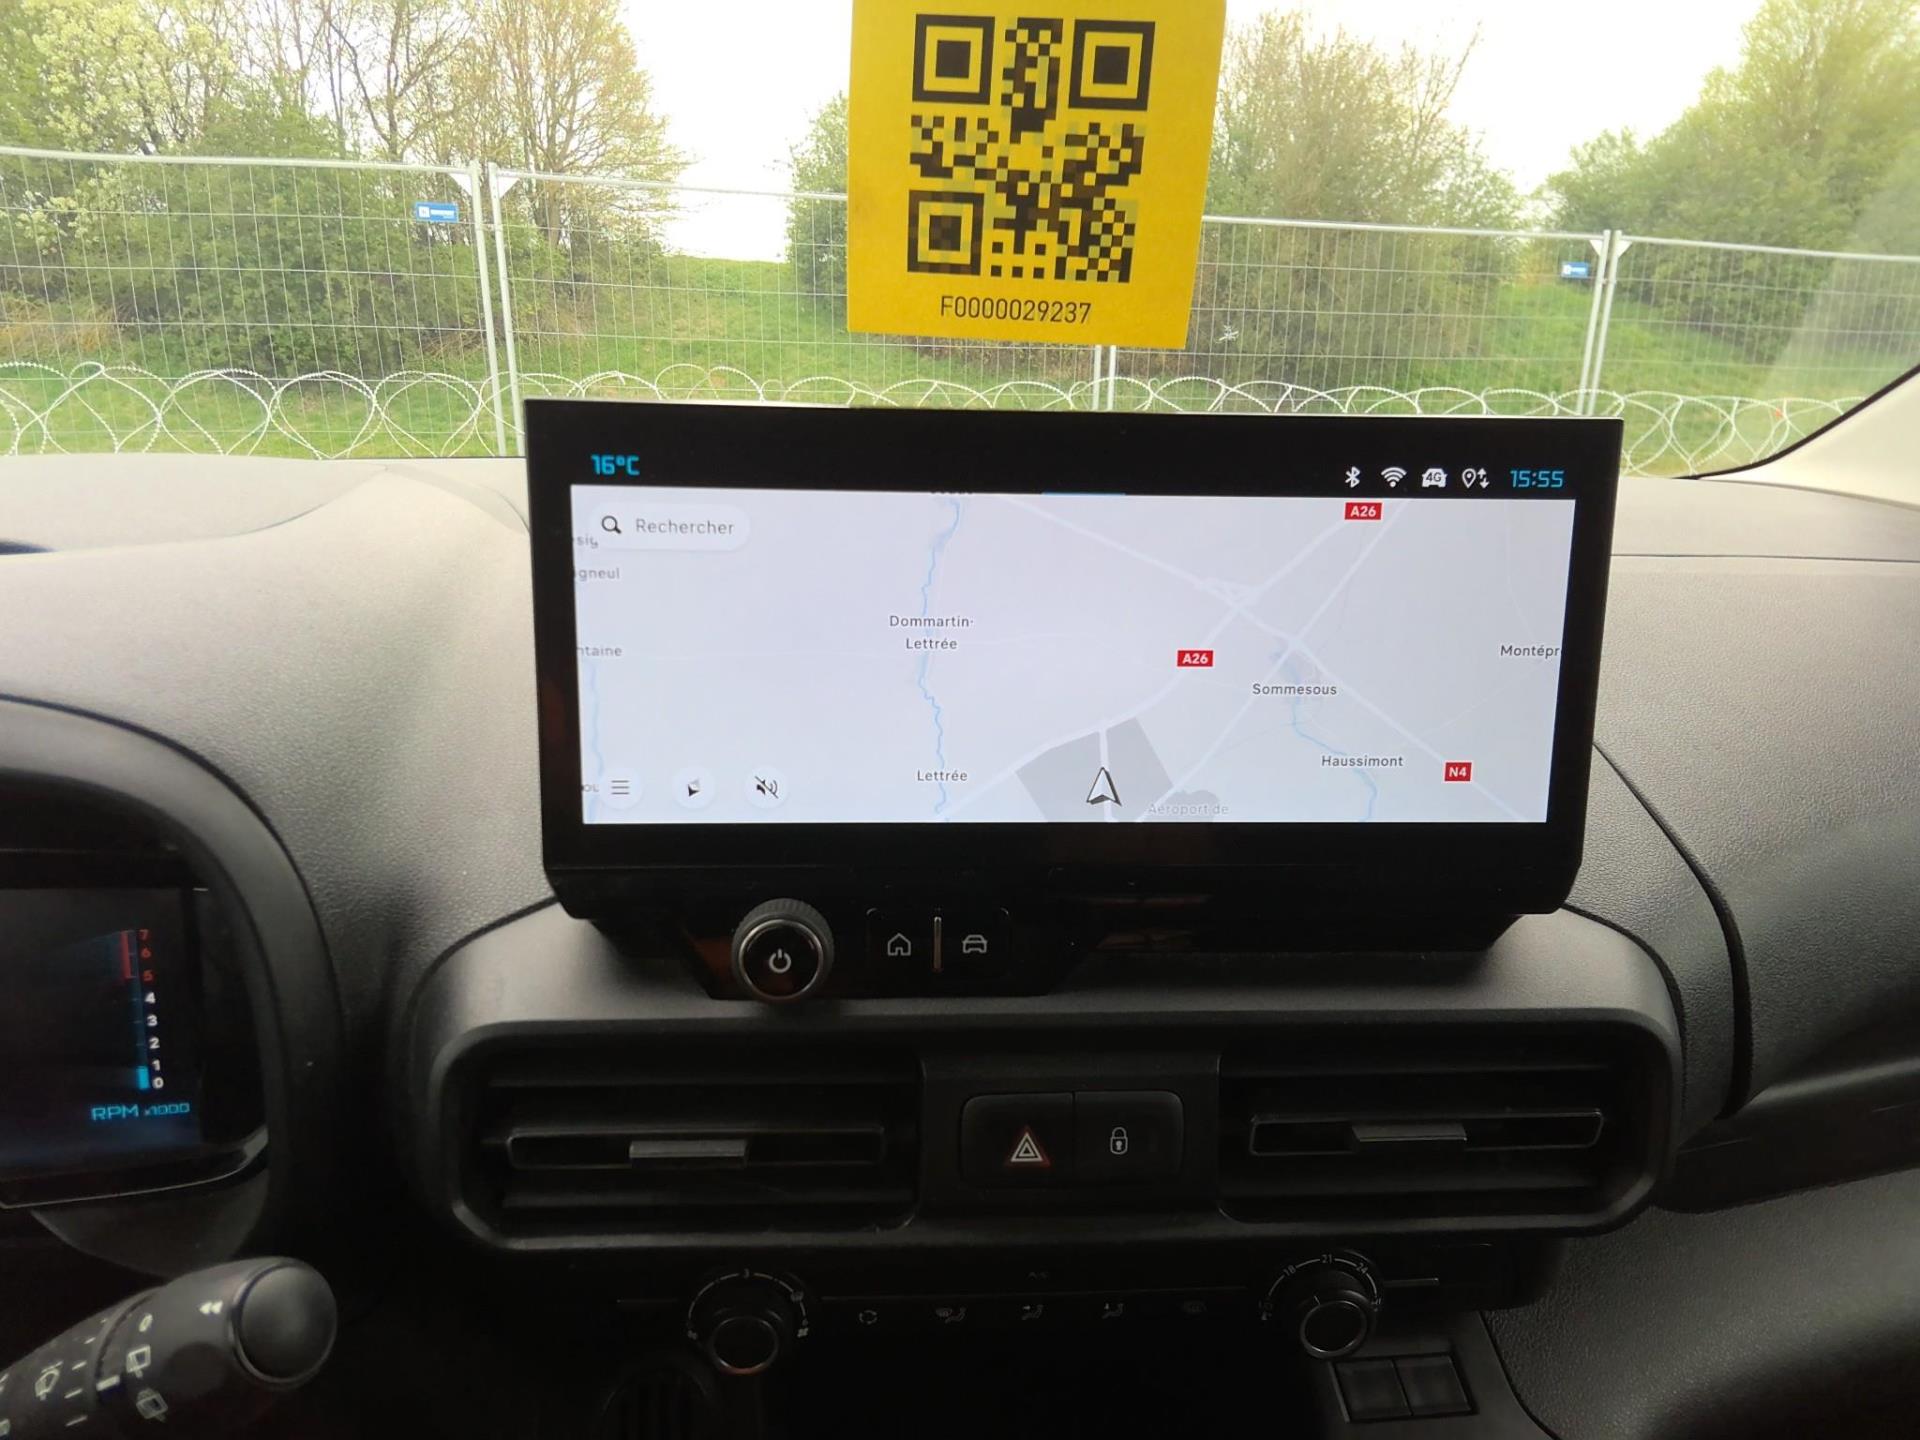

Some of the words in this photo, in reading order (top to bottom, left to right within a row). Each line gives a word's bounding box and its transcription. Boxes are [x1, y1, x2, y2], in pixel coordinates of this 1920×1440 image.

[939, 295, 1092, 324] F0000029237
[1510, 468, 1565, 488] 15:55
[1350, 504, 1377, 518] A26
[635, 518, 735, 537] Rechercher
[905, 636, 958, 651] Lettrée
[1181, 652, 1210, 665] A26
[1251, 682, 1338, 696] Sommesous
[1321, 754, 1404, 768] Haussimont
[916, 768, 969, 783] Lettrée
[1448, 765, 1467, 779] N4
[145, 992, 156, 1004] 4
[147, 1014, 158, 1027] 3
[149, 1037, 160, 1050] 2
[152, 1059, 161, 1071] 1
[91, 1103, 140, 1121] RPM
